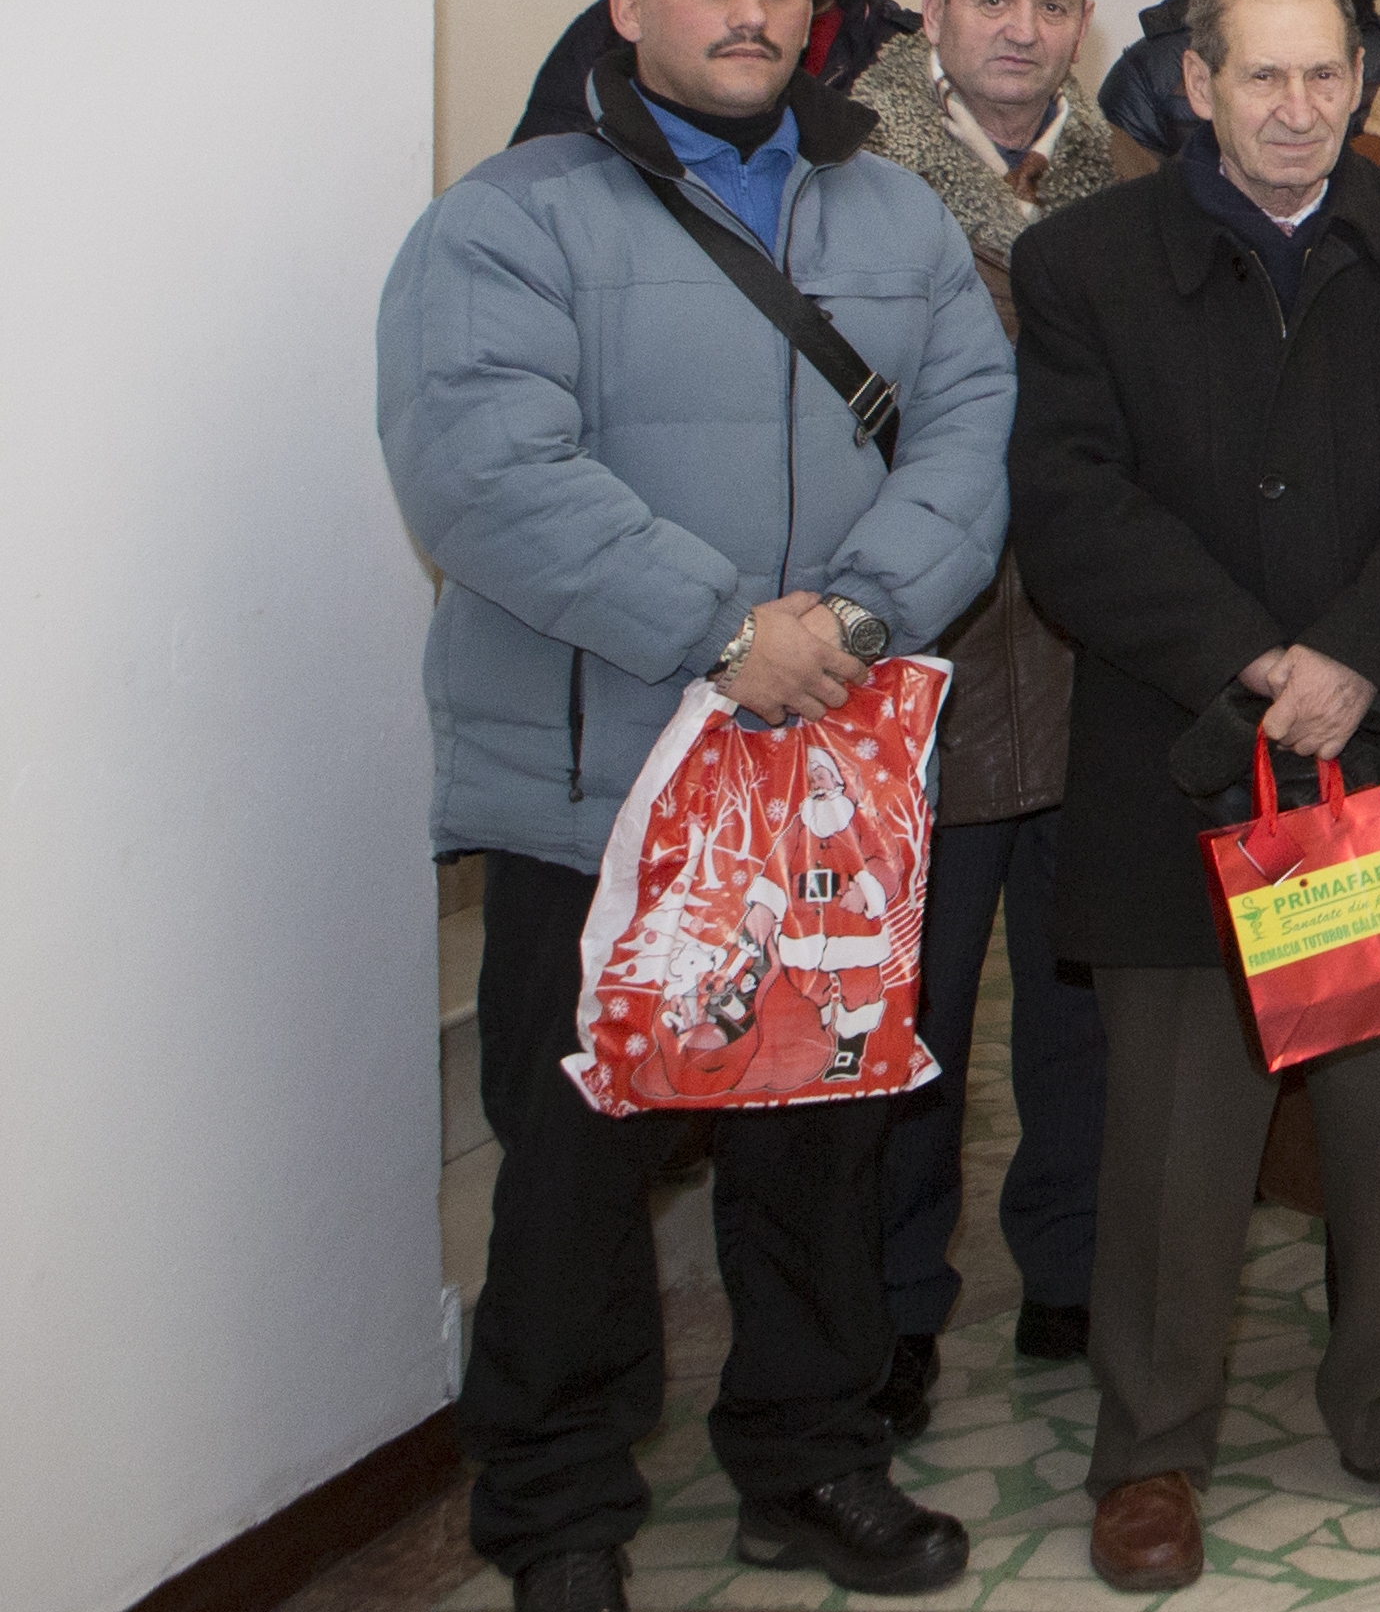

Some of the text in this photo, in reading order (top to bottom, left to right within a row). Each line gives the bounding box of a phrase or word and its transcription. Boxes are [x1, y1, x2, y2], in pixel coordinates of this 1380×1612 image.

[1347, 899, 1369, 914] din
[1248, 939, 1301, 969] FARMACIA
[1302, 924, 1351, 951] TUTUROR
